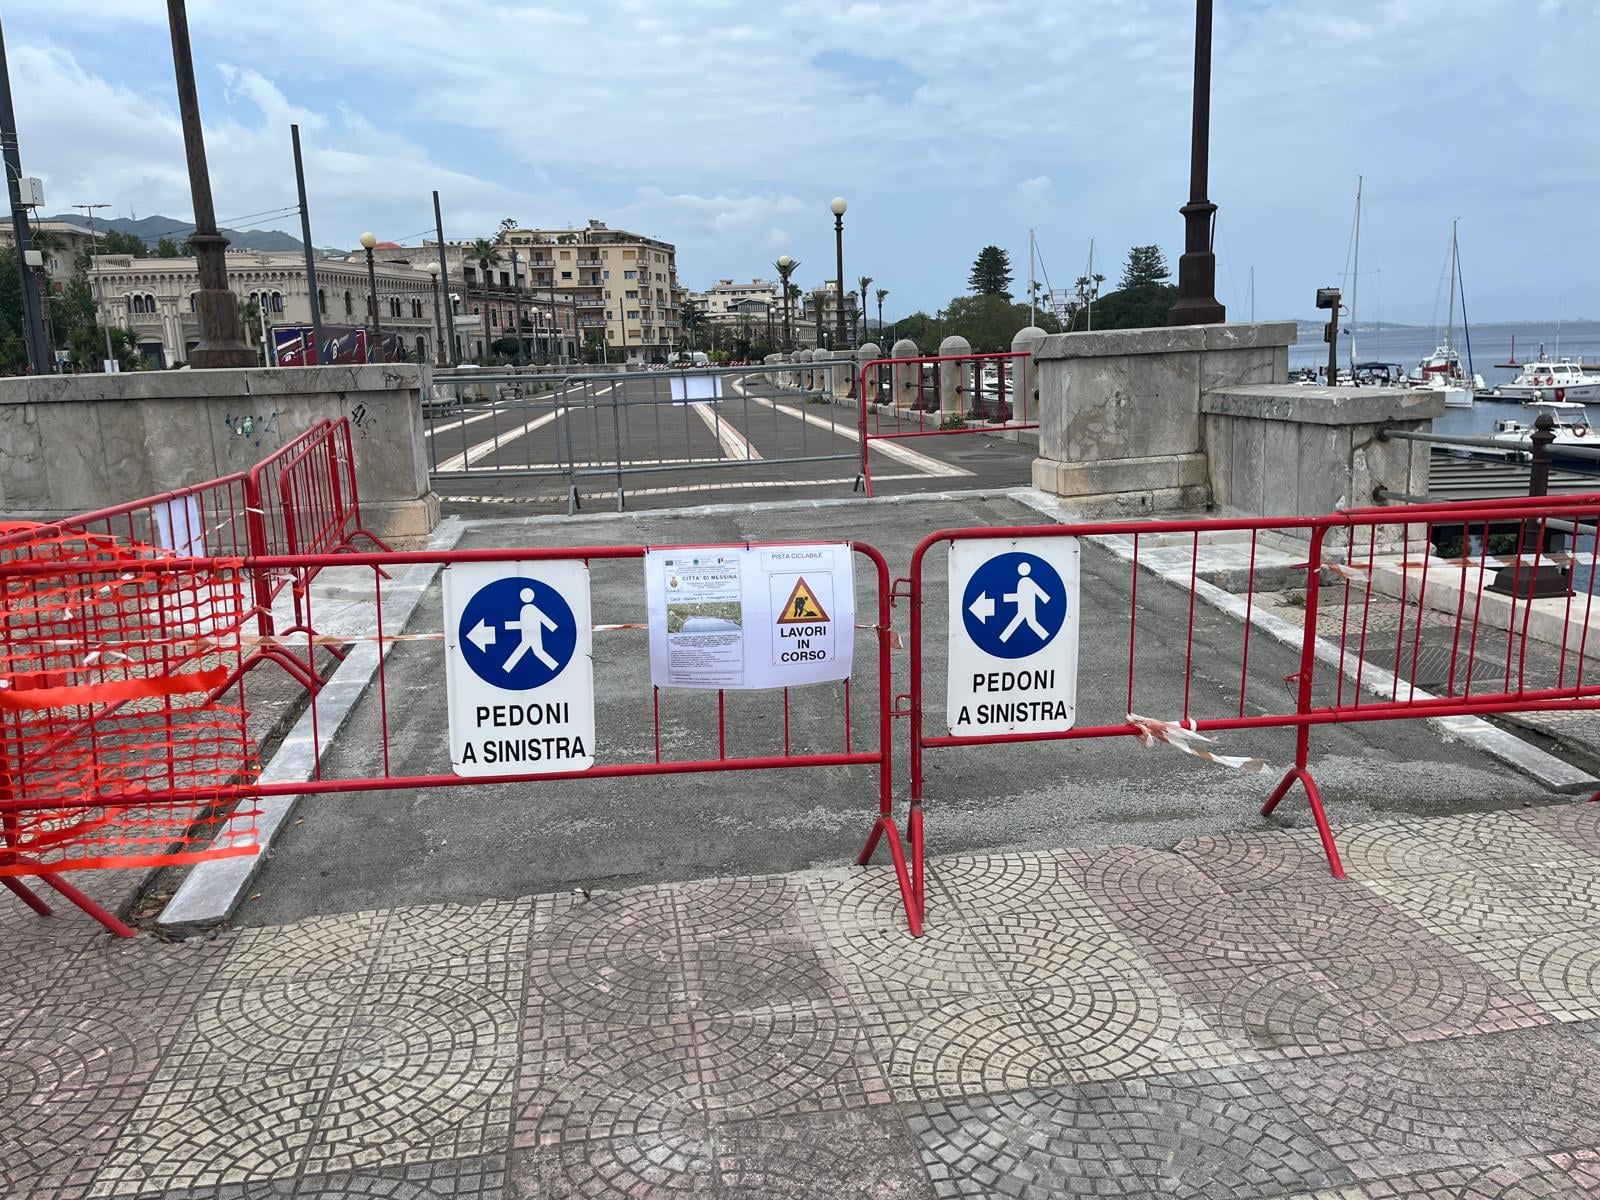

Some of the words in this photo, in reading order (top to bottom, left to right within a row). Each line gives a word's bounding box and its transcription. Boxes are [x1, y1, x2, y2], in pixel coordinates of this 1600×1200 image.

[780, 626, 826, 637] LAVORI
[781, 650, 826, 662] CORSO
[797, 639, 810, 649] IN
[973, 669, 1055, 693] PEDONI
[476, 702, 569, 728] PEDONI
[957, 706, 971, 725] A
[976, 700, 1067, 725] SINISTRA
[462, 742, 477, 764] A
[483, 736, 586, 764] SINISTRA
